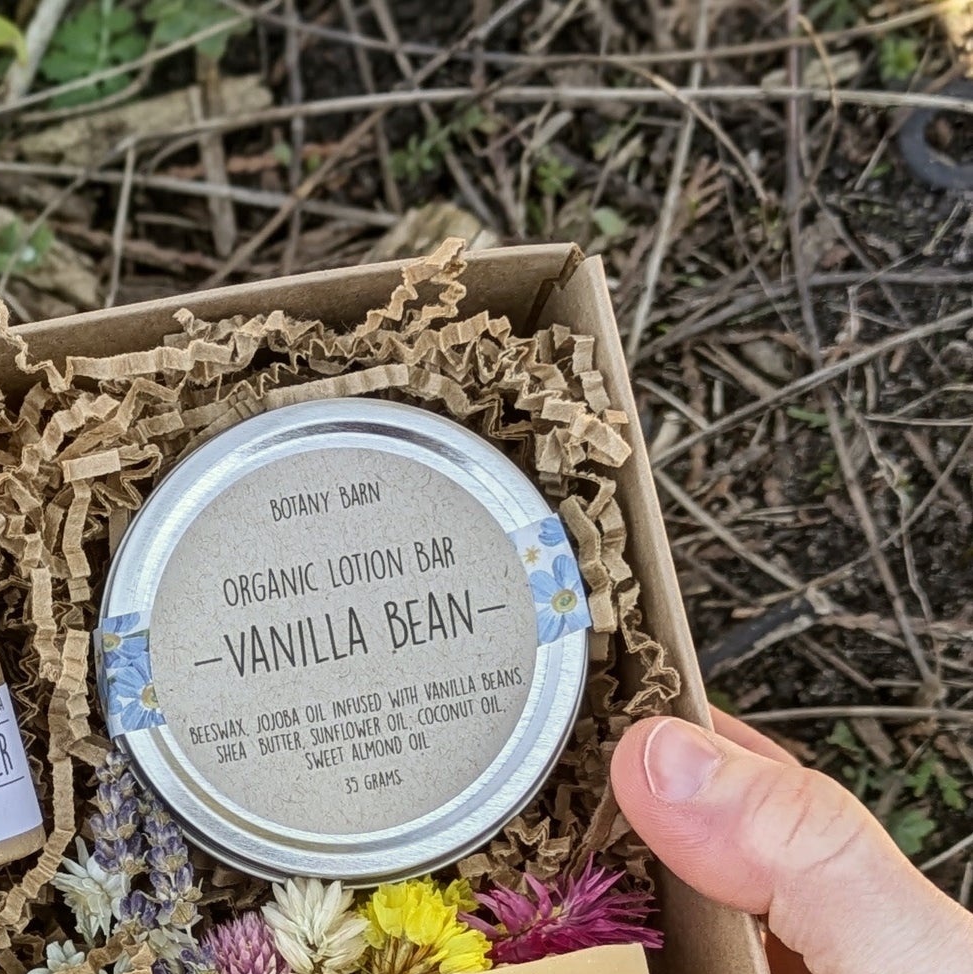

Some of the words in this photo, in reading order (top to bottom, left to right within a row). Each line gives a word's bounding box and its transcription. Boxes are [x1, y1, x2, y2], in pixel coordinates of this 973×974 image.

[270, 491, 330, 522] BOTANY
[339, 481, 382, 509] BARN
[223, 562, 318, 608] ORGANIC
[328, 546, 404, 588] LOTION
[414, 536, 457, 573] BAR
[256, 708, 300, 734] JOJOBA
[305, 703, 327, 723] OIL
[332, 693, 382, 719] INFUSED
[388, 685, 419, 709] WITH
[423, 675, 477, 701] VANILLA
[216, 741, 247, 764] SHEA
[310, 717, 381, 746] SUNFLOWER
[417, 699, 474, 726] COCONUT
[305, 746, 344, 770] SWEET
[352, 736, 402, 761] ALMOND
[409, 732, 430, 750] OIL
[344, 777, 358, 794] 35
[364, 769, 401, 790] GRAMS
